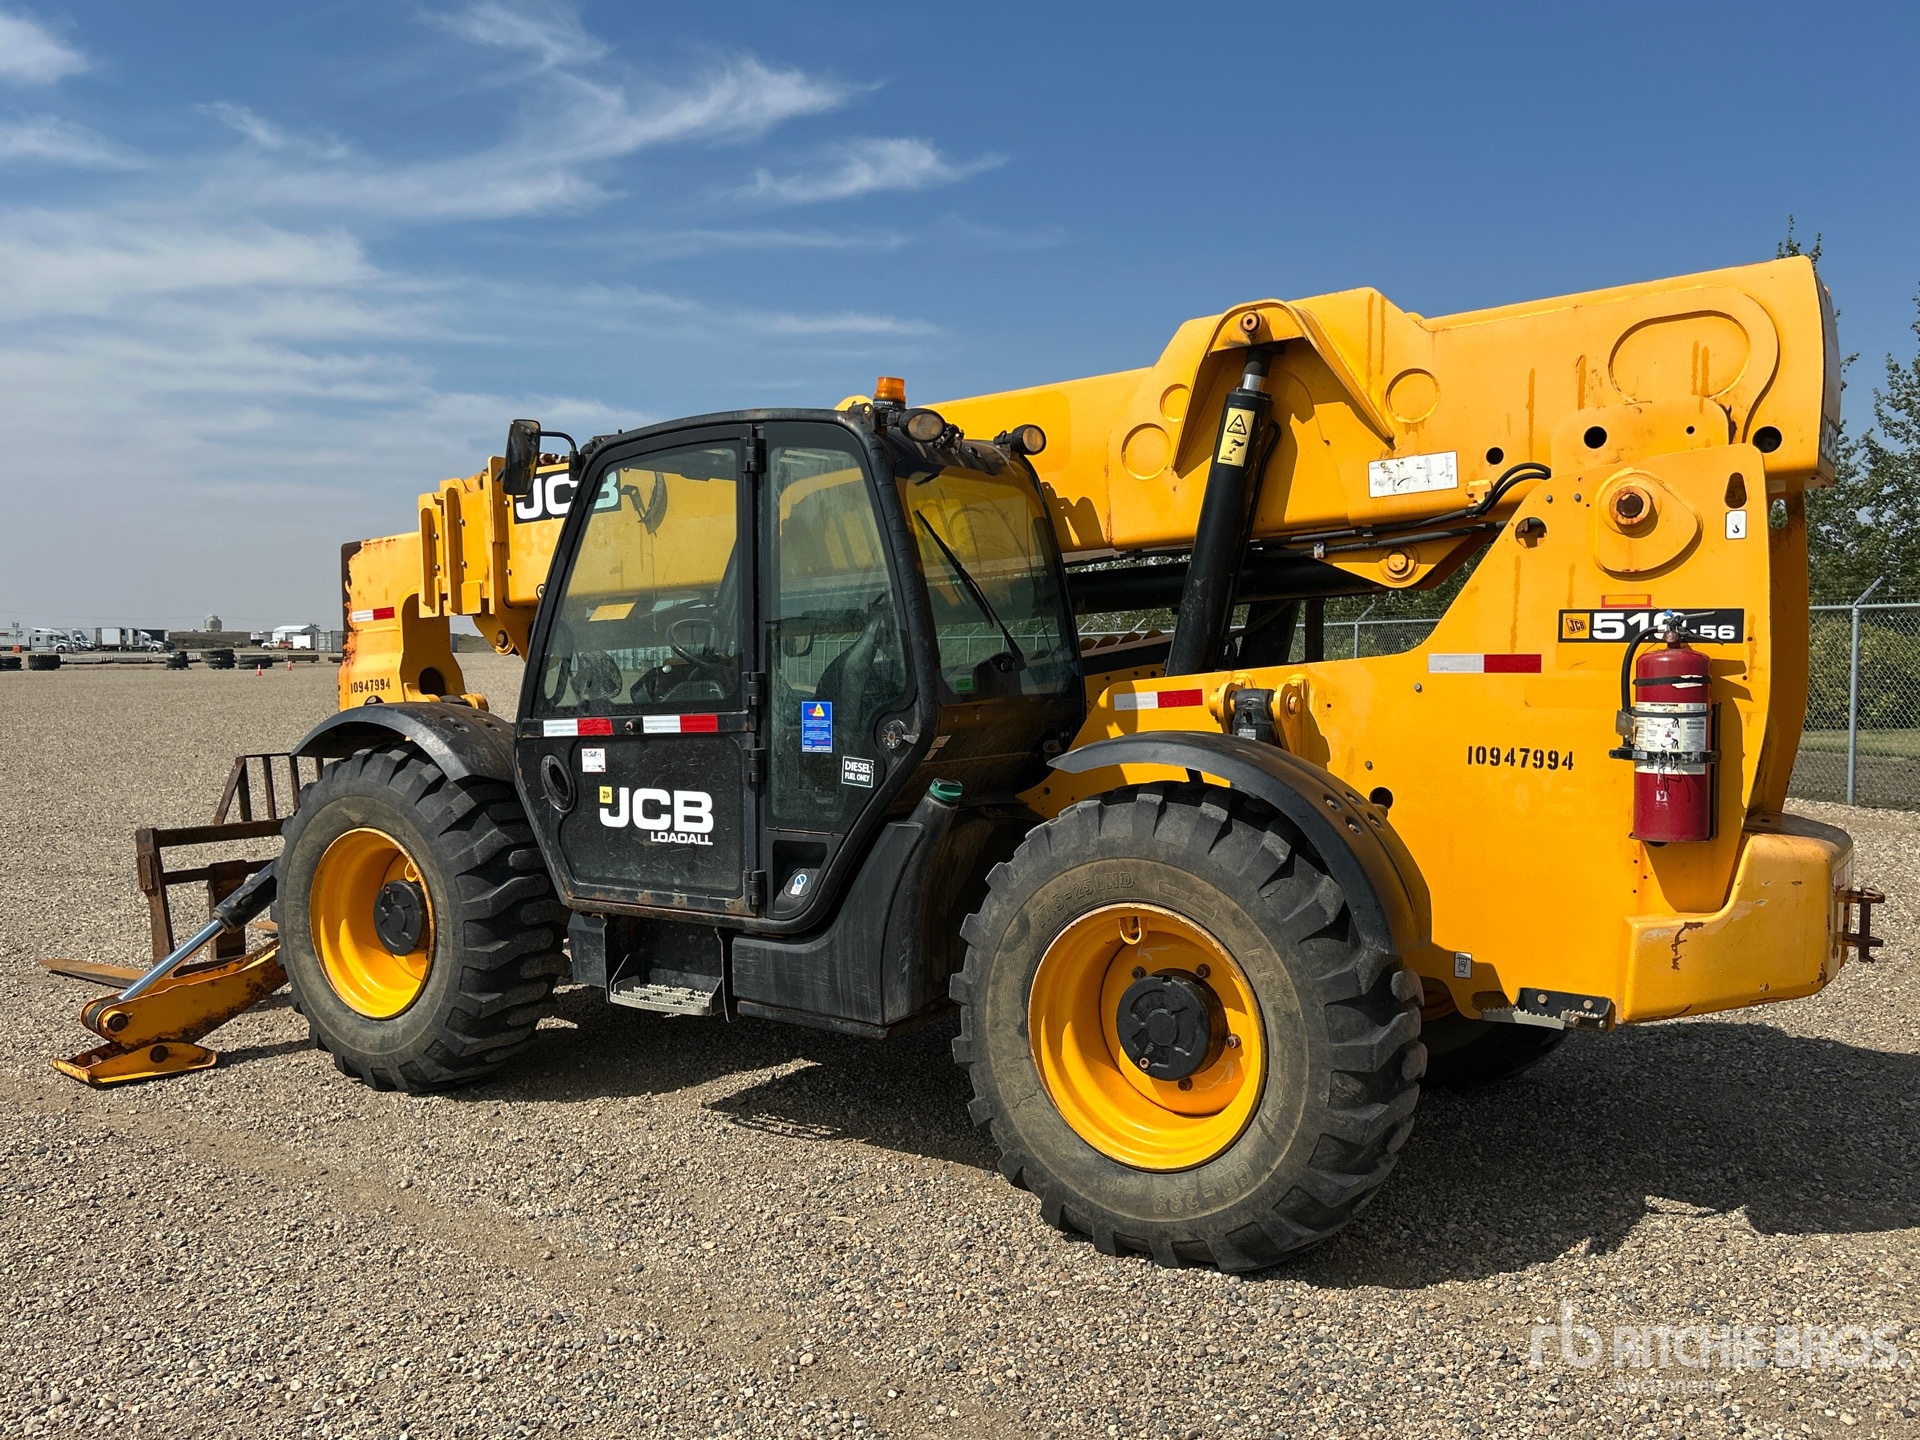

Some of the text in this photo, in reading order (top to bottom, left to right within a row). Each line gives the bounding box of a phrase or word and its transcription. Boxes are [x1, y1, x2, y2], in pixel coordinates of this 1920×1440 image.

[1567, 617, 1587, 634] JCB
[844, 760, 871, 773] DIESEL
[844, 771, 870, 782] FUEL ONLY
[599, 786, 714, 834] JCB
[650, 831, 713, 846] LOADALL
